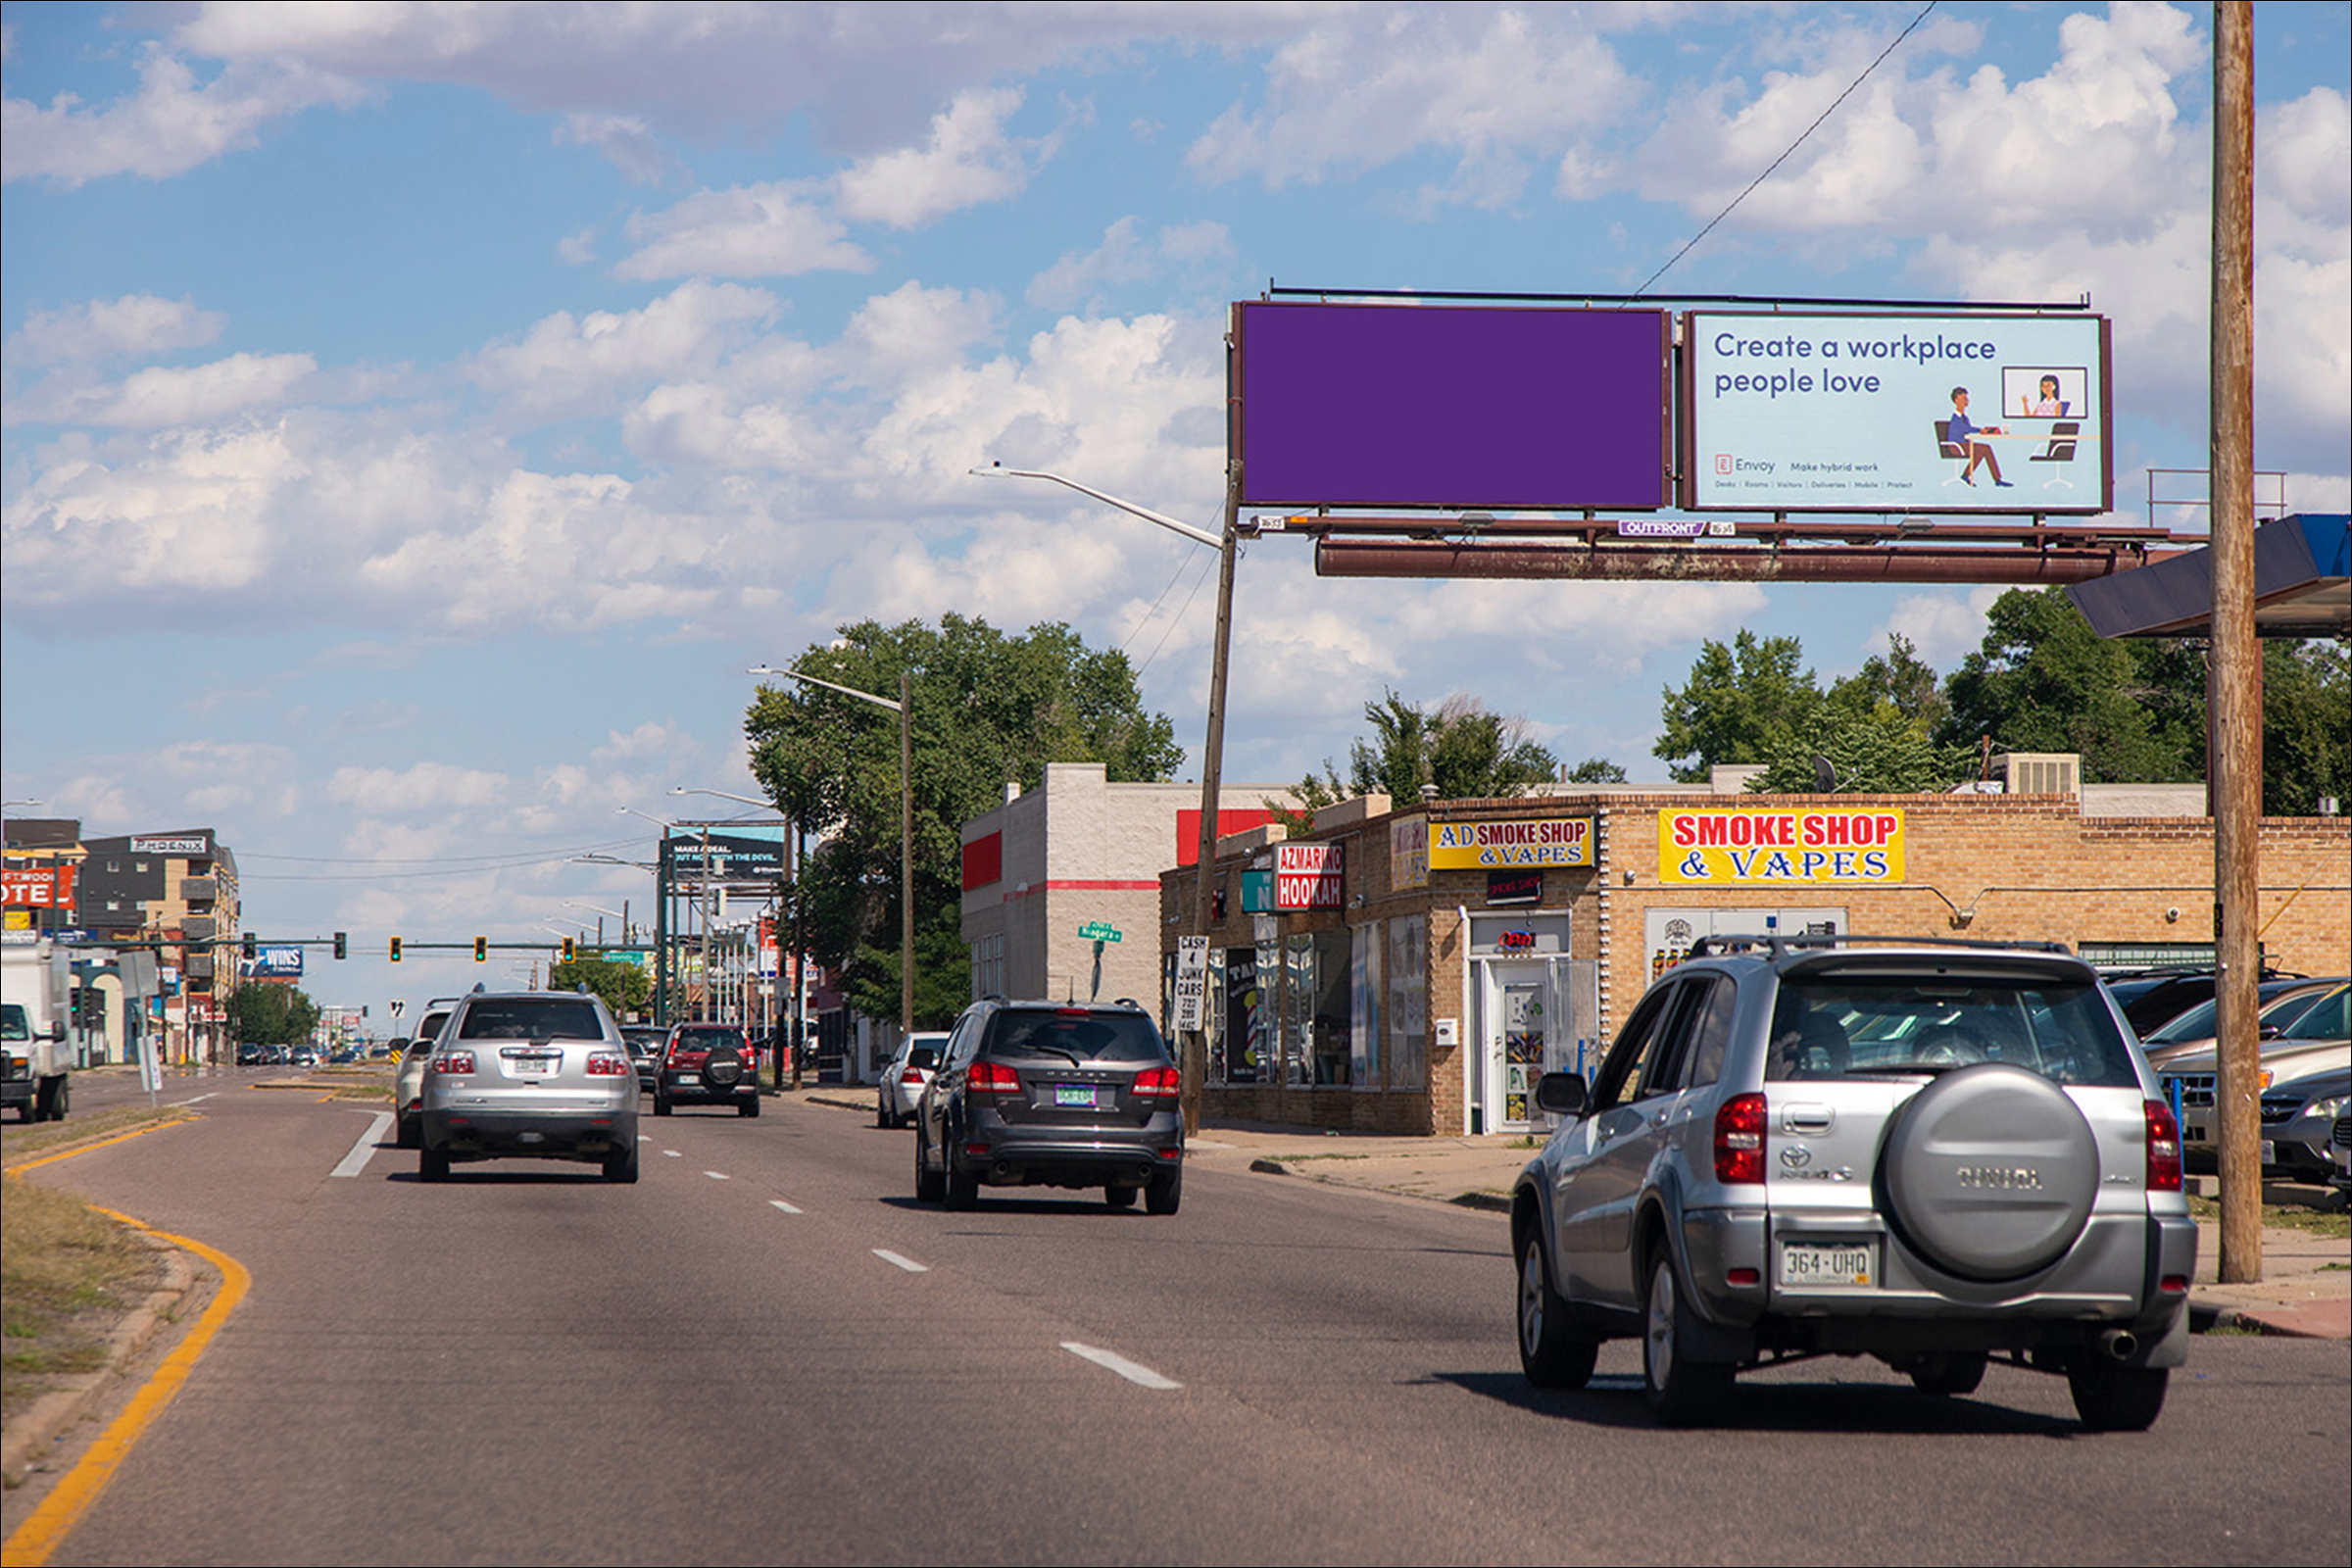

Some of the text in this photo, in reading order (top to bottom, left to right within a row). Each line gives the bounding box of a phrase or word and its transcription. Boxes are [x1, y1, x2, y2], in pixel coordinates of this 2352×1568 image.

[1715, 332, 1996, 365] Create a workplace
[1715, 368, 1881, 398] people love
[1736, 459, 1776, 474] Envoy
[1790, 463, 1879, 473] Make hybrid work
[1627, 522, 1696, 533] OUTFRONT
[1478, 823, 1536, 845] SMOKE
[1540, 822, 1586, 844] SHOP
[1674, 815, 1896, 846] SMOKE SHOP
[136, 840, 203, 851] PHOENIX
[1280, 847, 1342, 870] AZMARINO
[1480, 847, 1582, 863] & VAPES
[1680, 849, 1888, 877] & VAPES
[1280, 878, 1341, 905] HOOKAH
[1182, 937, 1205, 949] CASH
[267, 950, 300, 965] WINS
[1189, 952, 1195, 964] 4
[1177, 983, 1202, 996] CARS
[1957, 1167, 2042, 1189] TOYOTA
